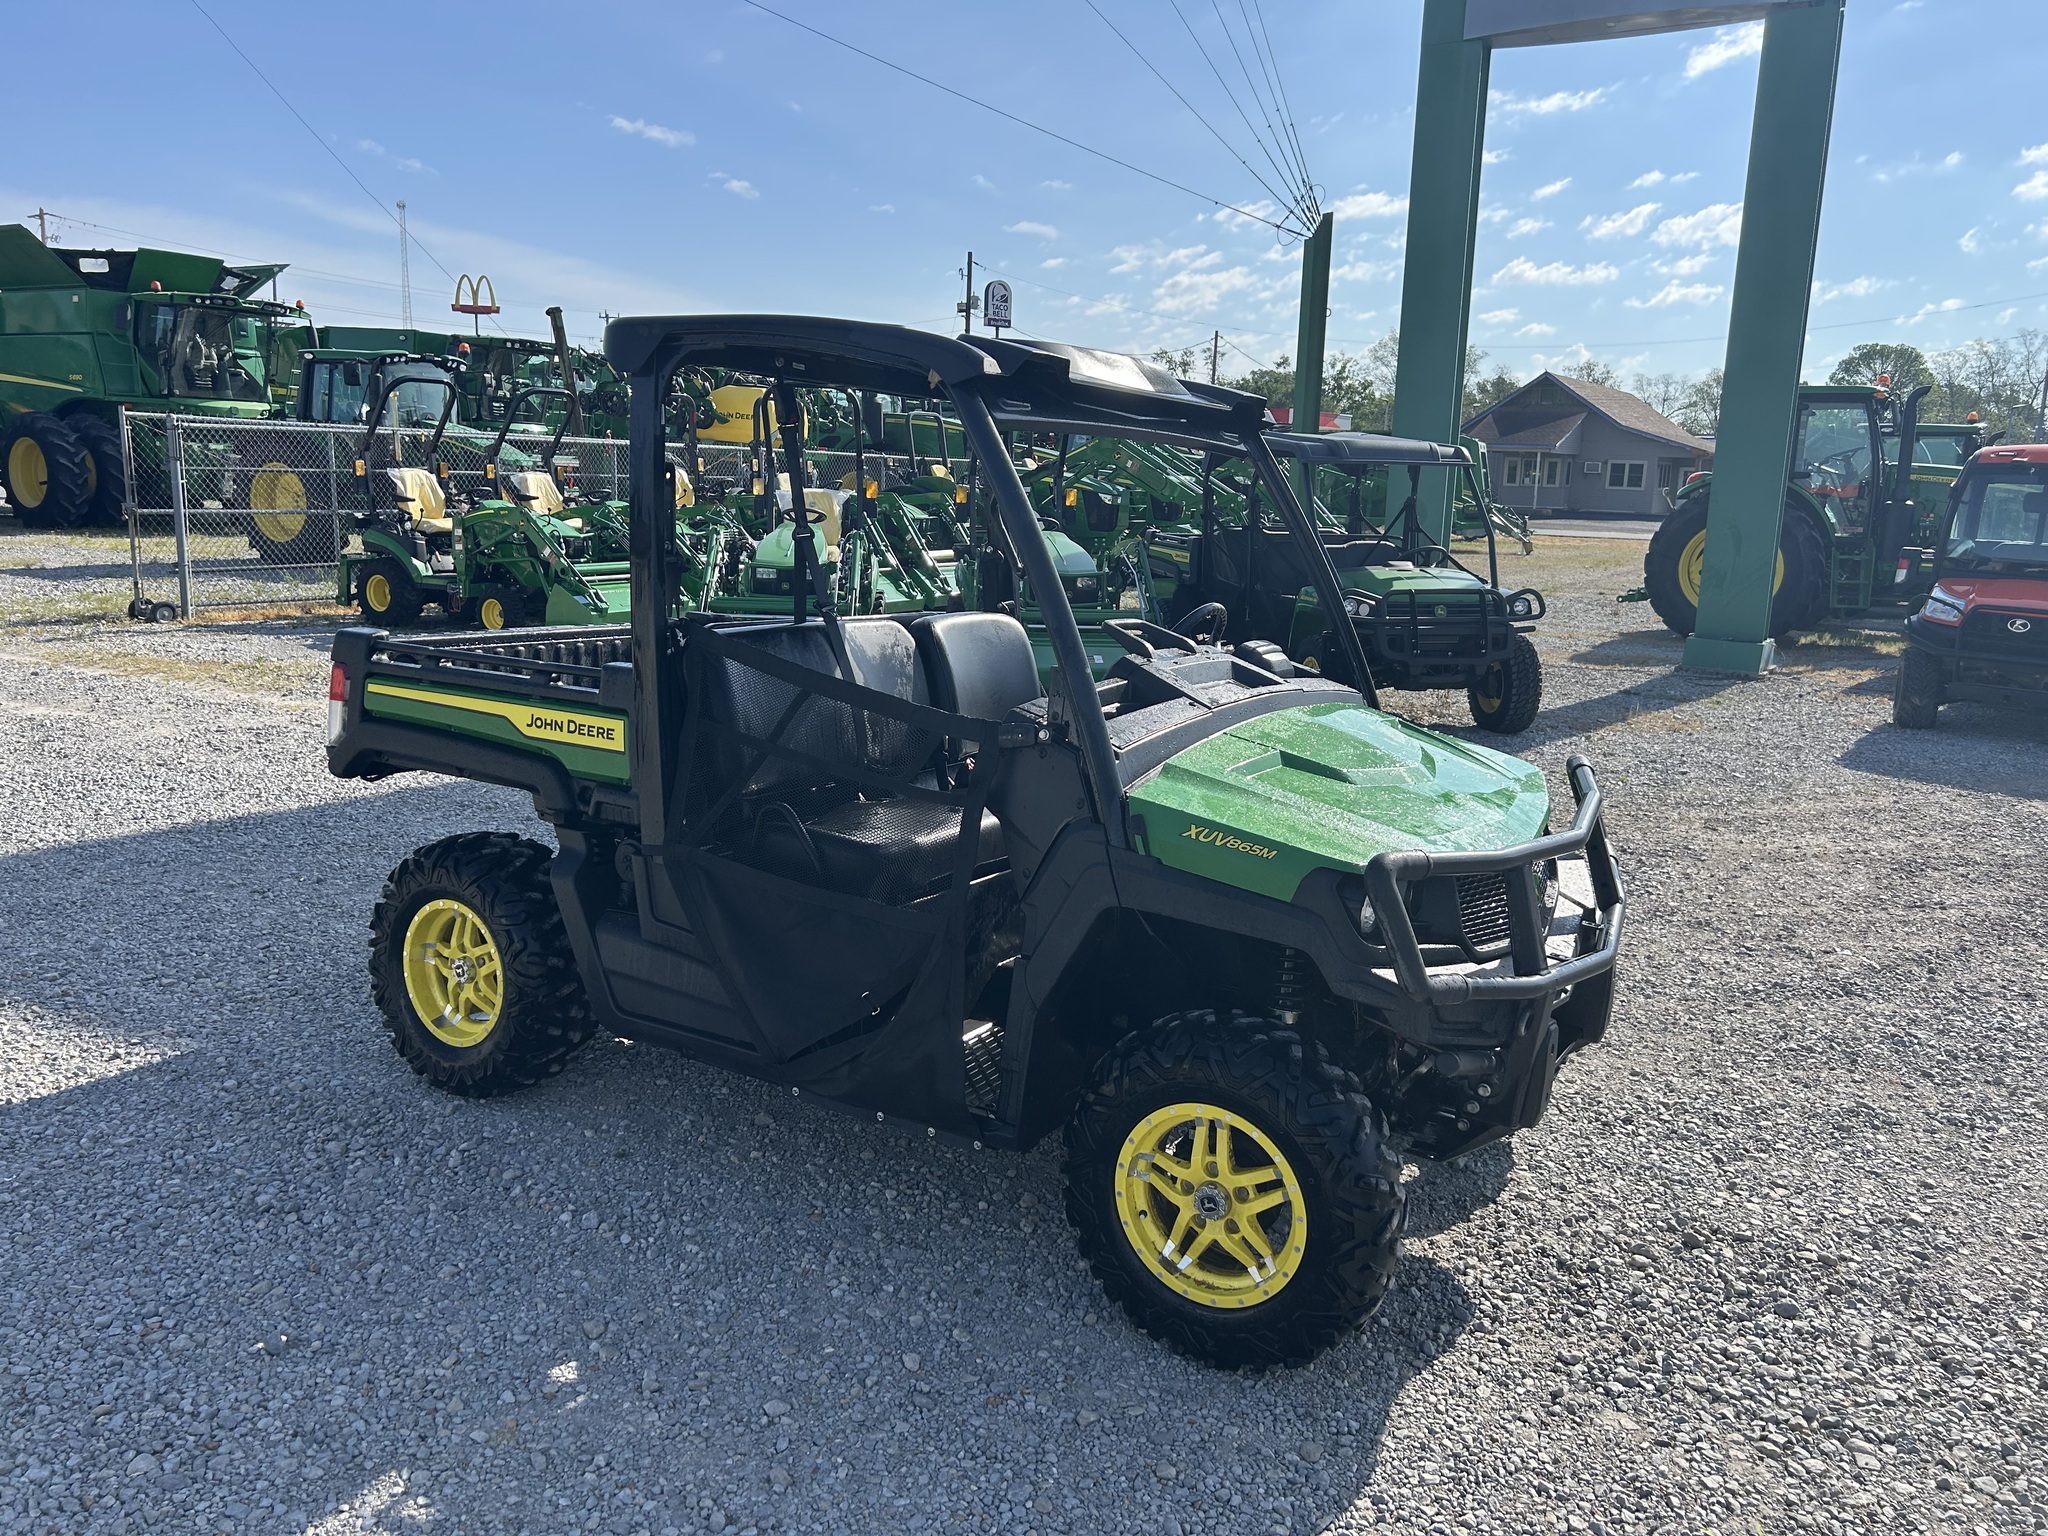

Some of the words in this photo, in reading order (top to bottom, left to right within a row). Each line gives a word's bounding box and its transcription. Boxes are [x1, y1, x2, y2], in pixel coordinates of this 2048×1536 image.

[992, 303, 1008, 312] TACO
[993, 310, 1008, 318] BELL
[526, 713, 563, 732] JOHN
[567, 719, 615, 740] DEERE
[1181, 823, 1278, 860] XUV865M
